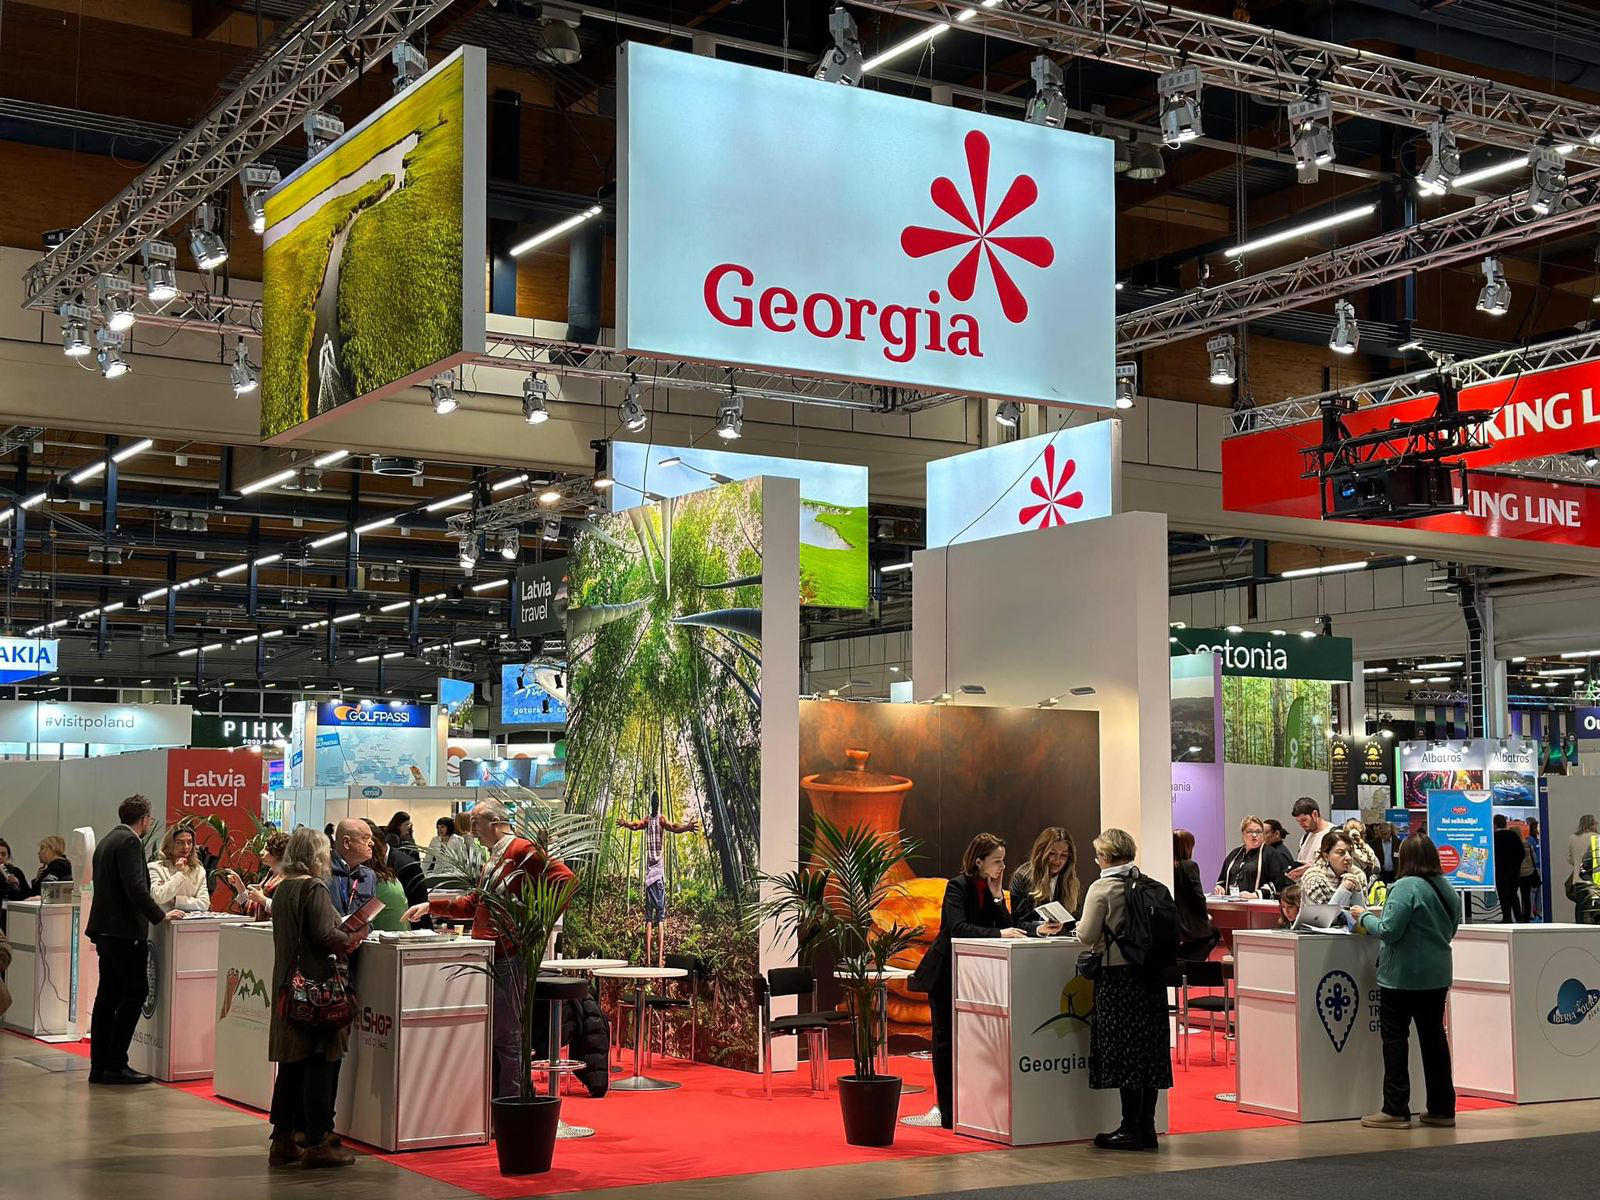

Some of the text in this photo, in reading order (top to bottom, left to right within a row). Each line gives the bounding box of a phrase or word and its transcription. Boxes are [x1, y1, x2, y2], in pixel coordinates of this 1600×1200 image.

[703, 263, 984, 363] Georgia
[1524, 495, 1581, 528] LINE
[521, 576, 552, 601] Latvia
[521, 598, 548, 624] travel
[45, 713, 135, 732] #visitpoland
[348, 711, 410, 723] GOLFPASSI
[223, 720, 293, 739] PIHK
[1421, 752, 1462, 763] Albatros
[1493, 752, 1530, 764] Albatros
[183, 768, 246, 788] Latvia
[182, 788, 238, 807] travel
[1553, 1010, 1577, 1023] IBERIA
[1019, 1053, 1090, 1075] Georgia
